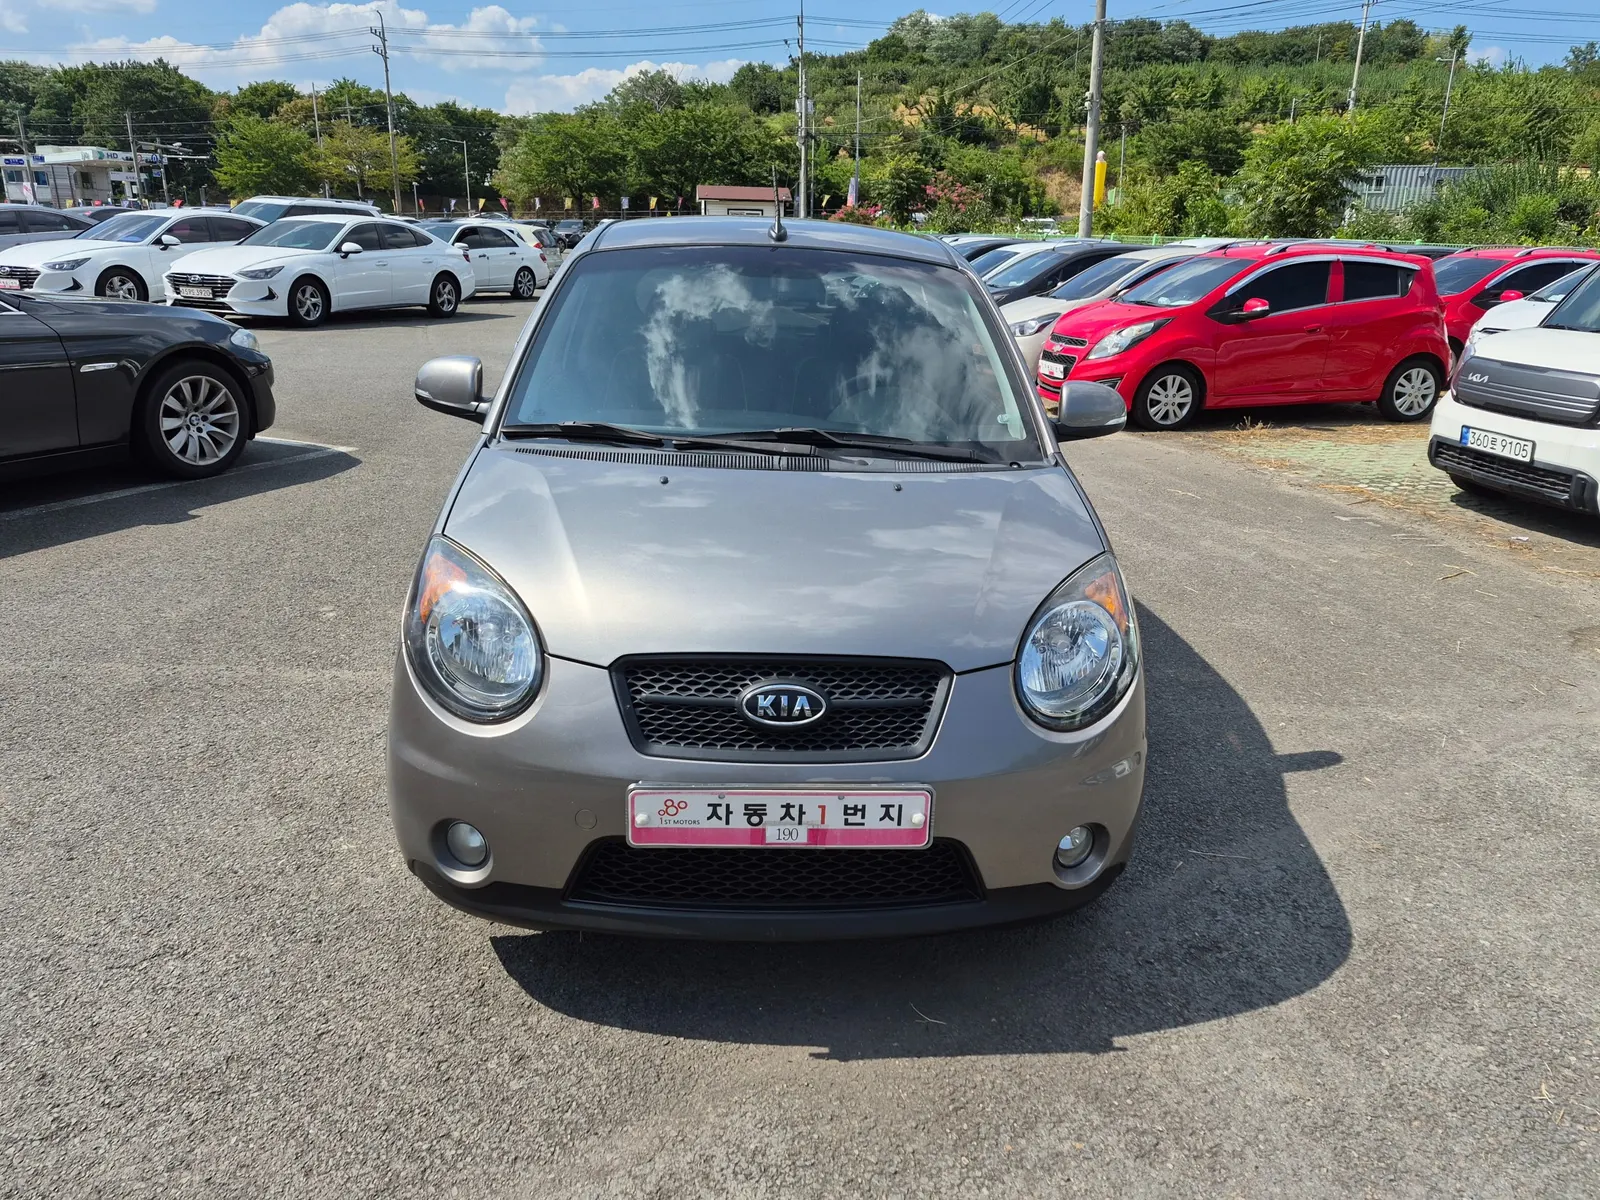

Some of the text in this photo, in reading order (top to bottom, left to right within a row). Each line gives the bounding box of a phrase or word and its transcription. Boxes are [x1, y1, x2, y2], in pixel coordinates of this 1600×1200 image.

[1470, 431, 1529, 458] 360로 9105
[756, 694, 813, 717] KIA
[776, 827, 799, 841] 190
